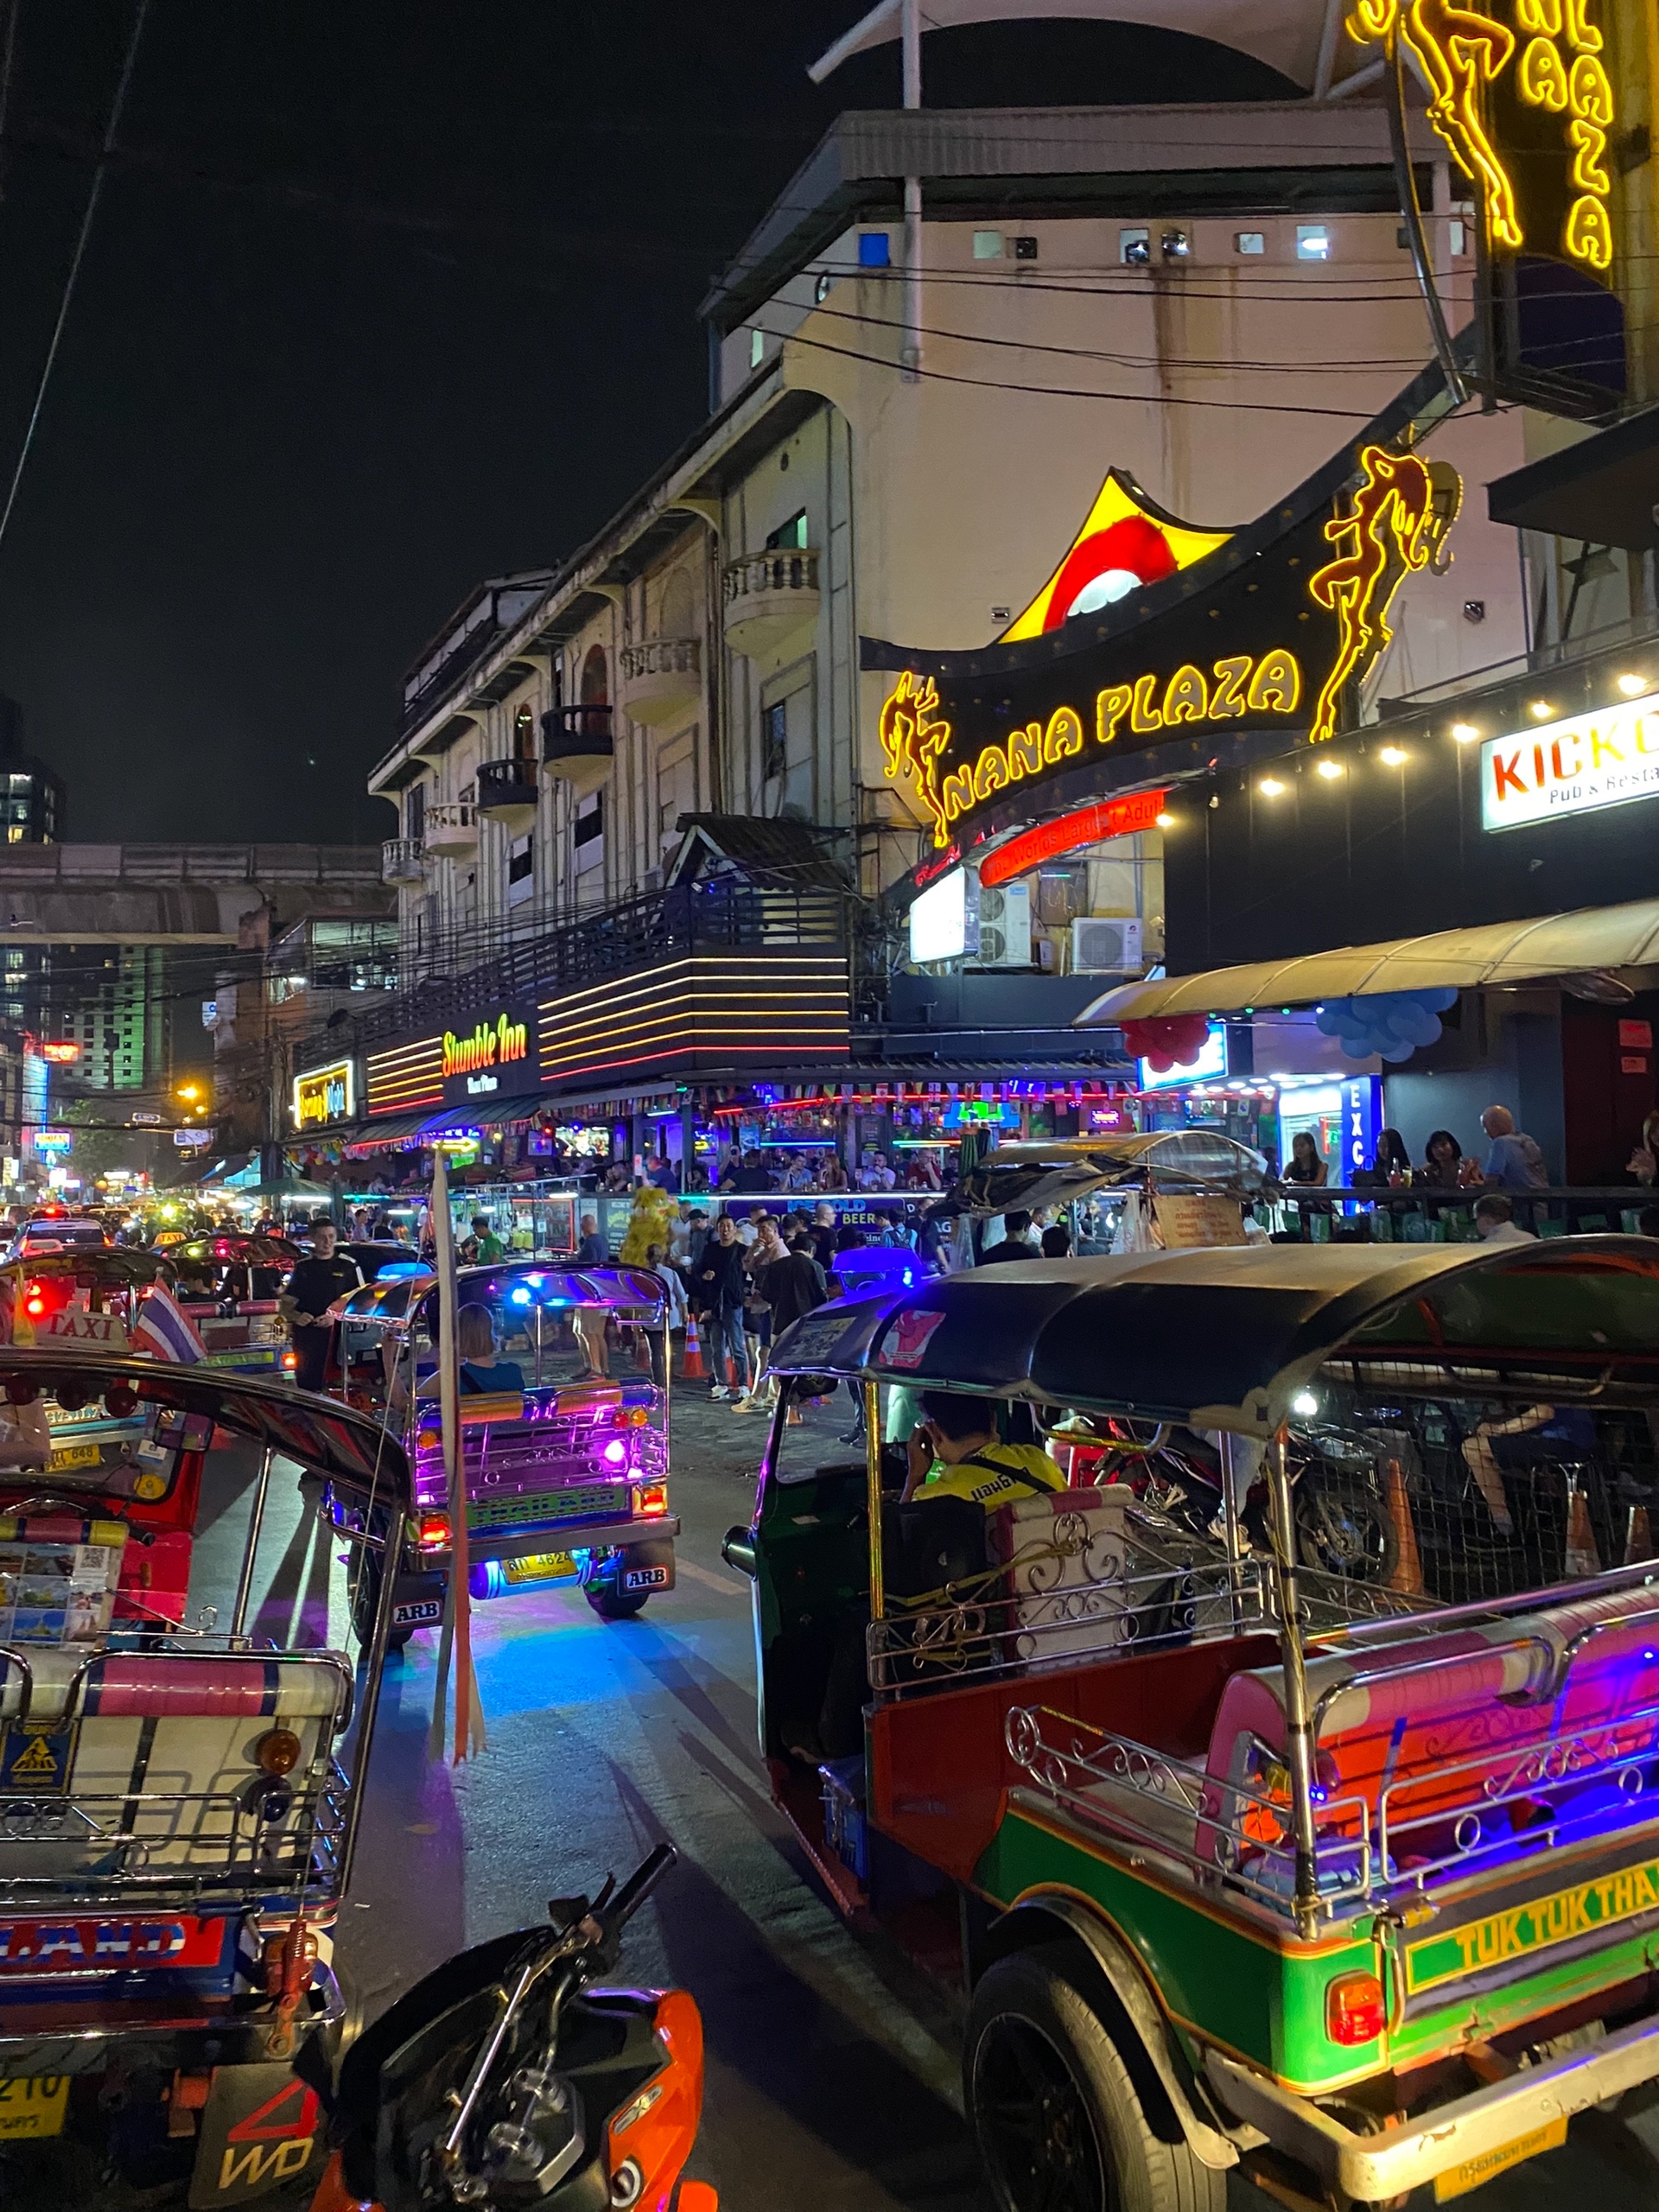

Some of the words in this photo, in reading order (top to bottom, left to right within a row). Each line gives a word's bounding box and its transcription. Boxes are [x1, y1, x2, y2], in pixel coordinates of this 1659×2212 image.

[943, 707, 1083, 821] NANA
[1096, 649, 1300, 742] PLAZA
[1550, 785, 1581, 804] Pub
[442, 1022, 496, 1077] Stumble
[498, 1013, 526, 1063] Inn
[787, 1198, 816, 1213] ICE
[842, 1212, 875, 1224] BEER
[161, 1234, 182, 1243] TAXI
[47, 1313, 114, 1341] TAXI
[537, 1552, 572, 1567] 4624
[628, 1568, 665, 1588] ARB
[396, 1602, 438, 1623] ARB
[1455, 1910, 1523, 1968] TUK
[1528, 1886, 1592, 1943] TUK
[1595, 1864, 1659, 1918] THA
[227, 2077, 320, 2142] 4
[219, 2136, 315, 2190] WD
